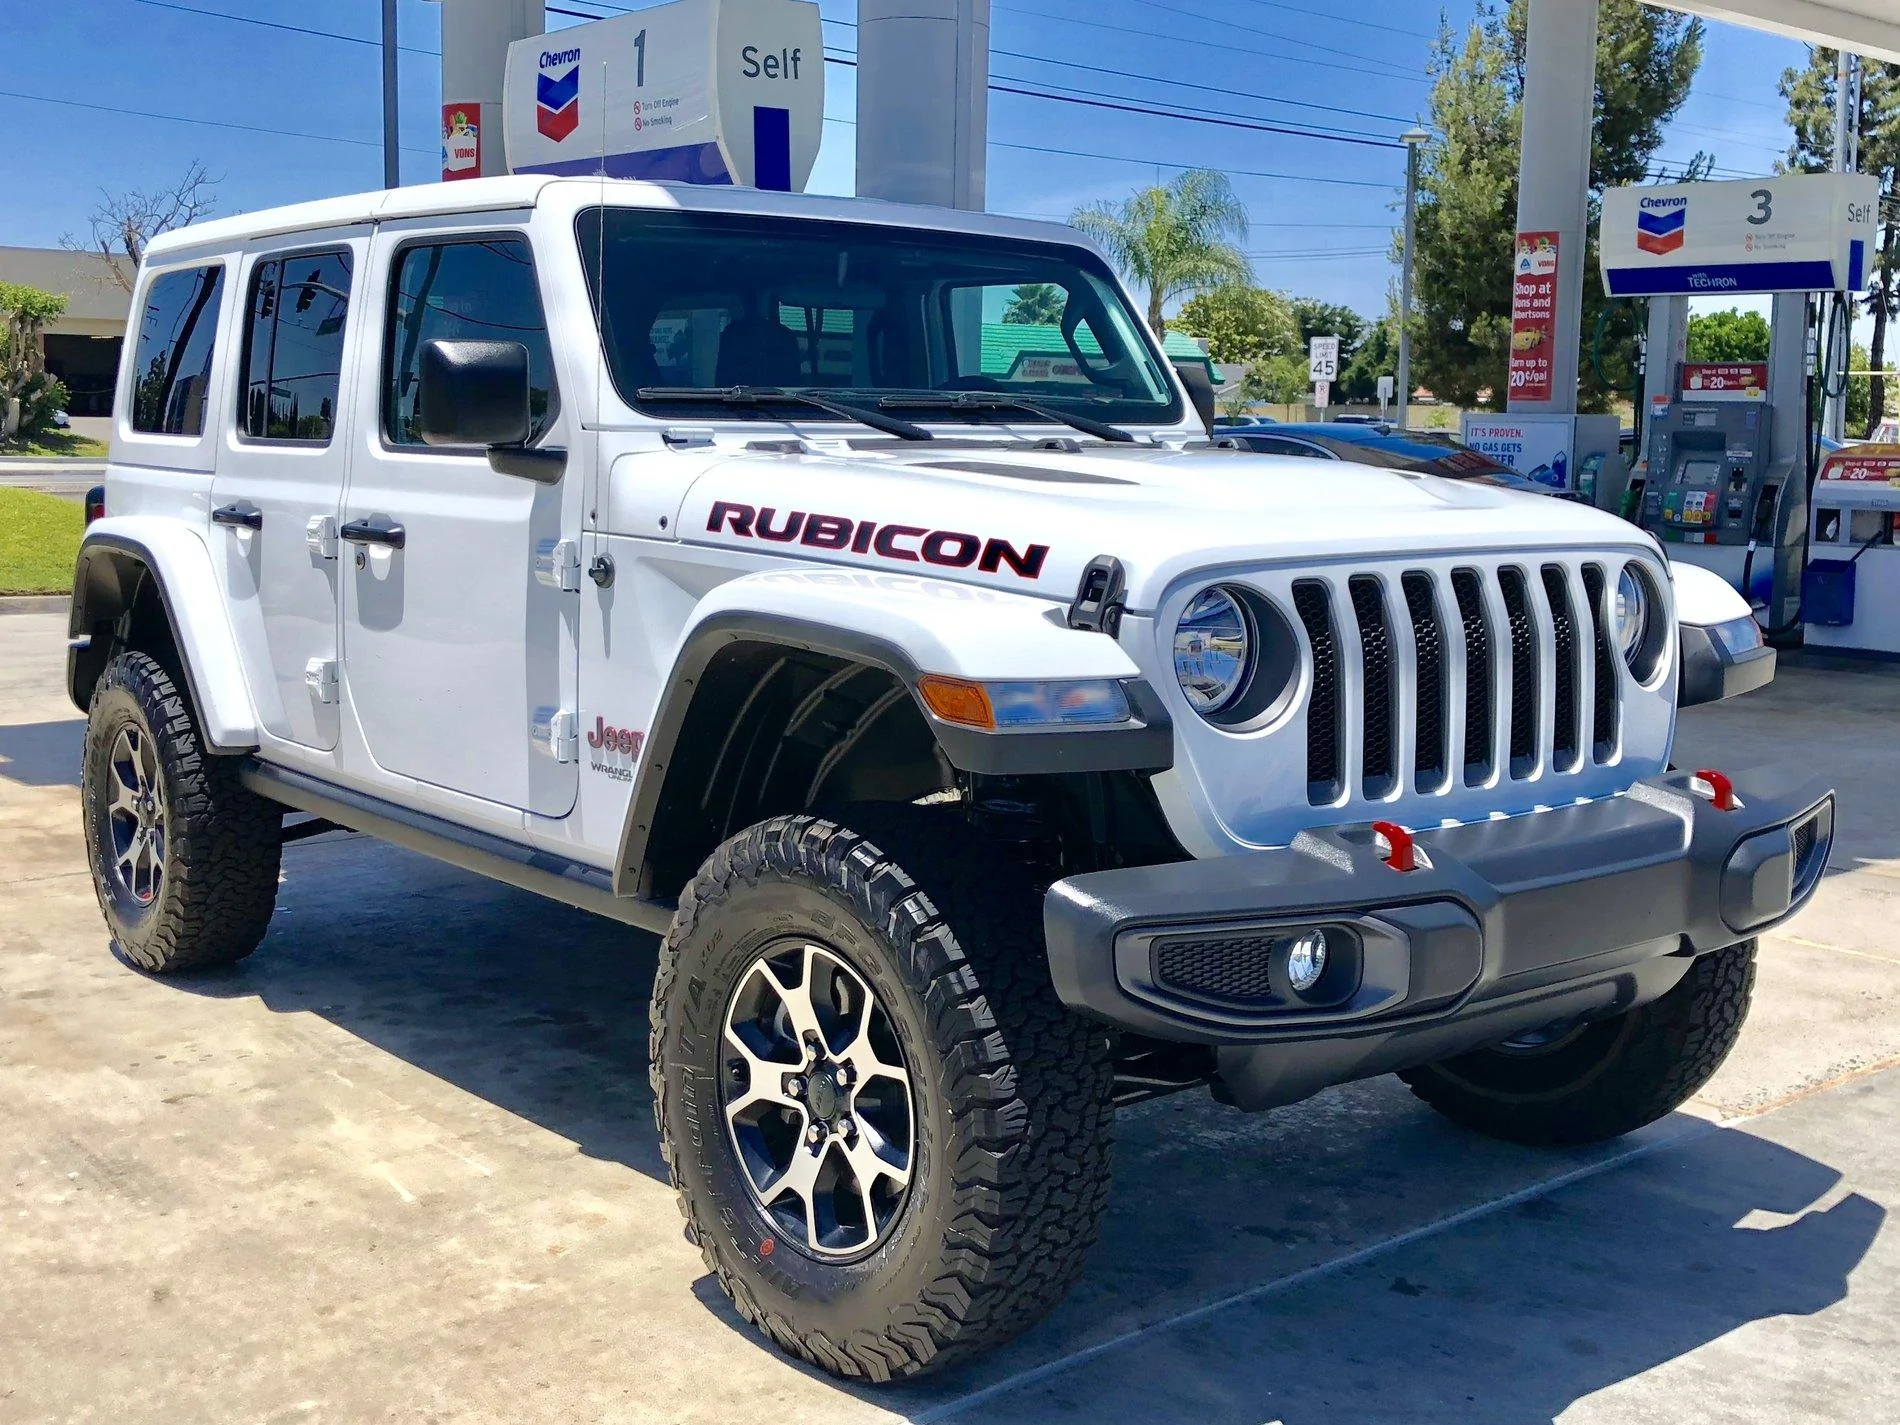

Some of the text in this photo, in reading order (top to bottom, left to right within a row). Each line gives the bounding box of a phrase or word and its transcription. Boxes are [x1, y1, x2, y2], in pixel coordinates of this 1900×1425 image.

[539, 48, 580, 69] Chevron
[633, 29, 647, 87] 1
[741, 46, 801, 80] Self
[651, 115, 672, 127] Smoking
[454, 148, 475, 159] VONS
[1639, 196, 1687, 209] Chevron
[1746, 189, 1773, 225] 3
[1847, 202, 1871, 224] Self
[1515, 282, 1552, 297] Shop at
[1687, 277, 1738, 288] TECHRON
[1532, 297, 1551, 308] and
[1313, 360, 1335, 376] 45
[1525, 359, 1536, 369] up
[1538, 357, 1548, 367] to
[1710, 377, 1724, 389] 20
[1471, 428, 1523, 438] IT'S PROVEN.
[1483, 443, 1499, 452] GAS
[1501, 443, 1522, 453] GETS
[1850, 467, 1867, 480] 20
[706, 500, 1050, 580] RUBICON
[588, 716, 645, 763] Jeep
[591, 760, 633, 779] WRANGL
